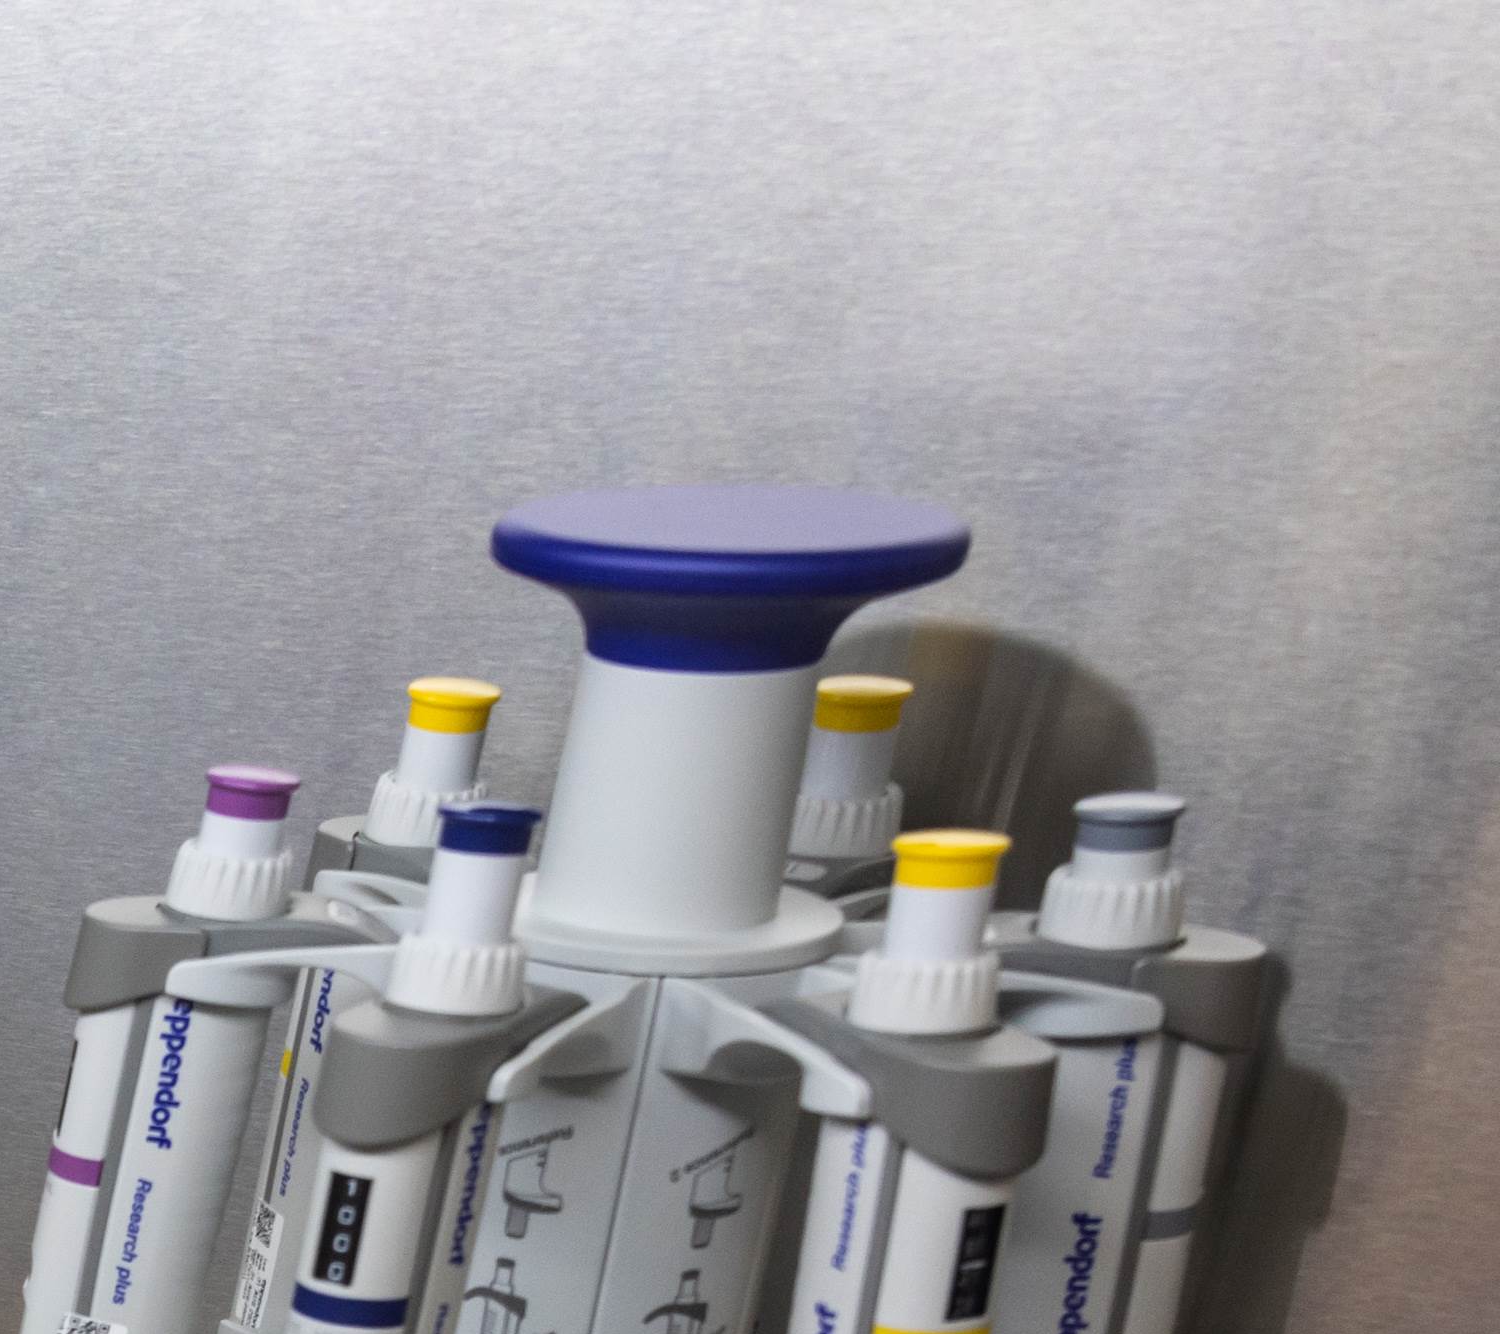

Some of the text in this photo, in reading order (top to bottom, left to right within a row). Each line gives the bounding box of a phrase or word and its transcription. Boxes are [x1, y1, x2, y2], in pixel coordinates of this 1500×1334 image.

[146, 997, 194, 1150] eppendorf
[1093, 1085, 1131, 1179] Research
[112, 1177, 153, 1305] Research plus
[831, 1173, 860, 1272] Research
